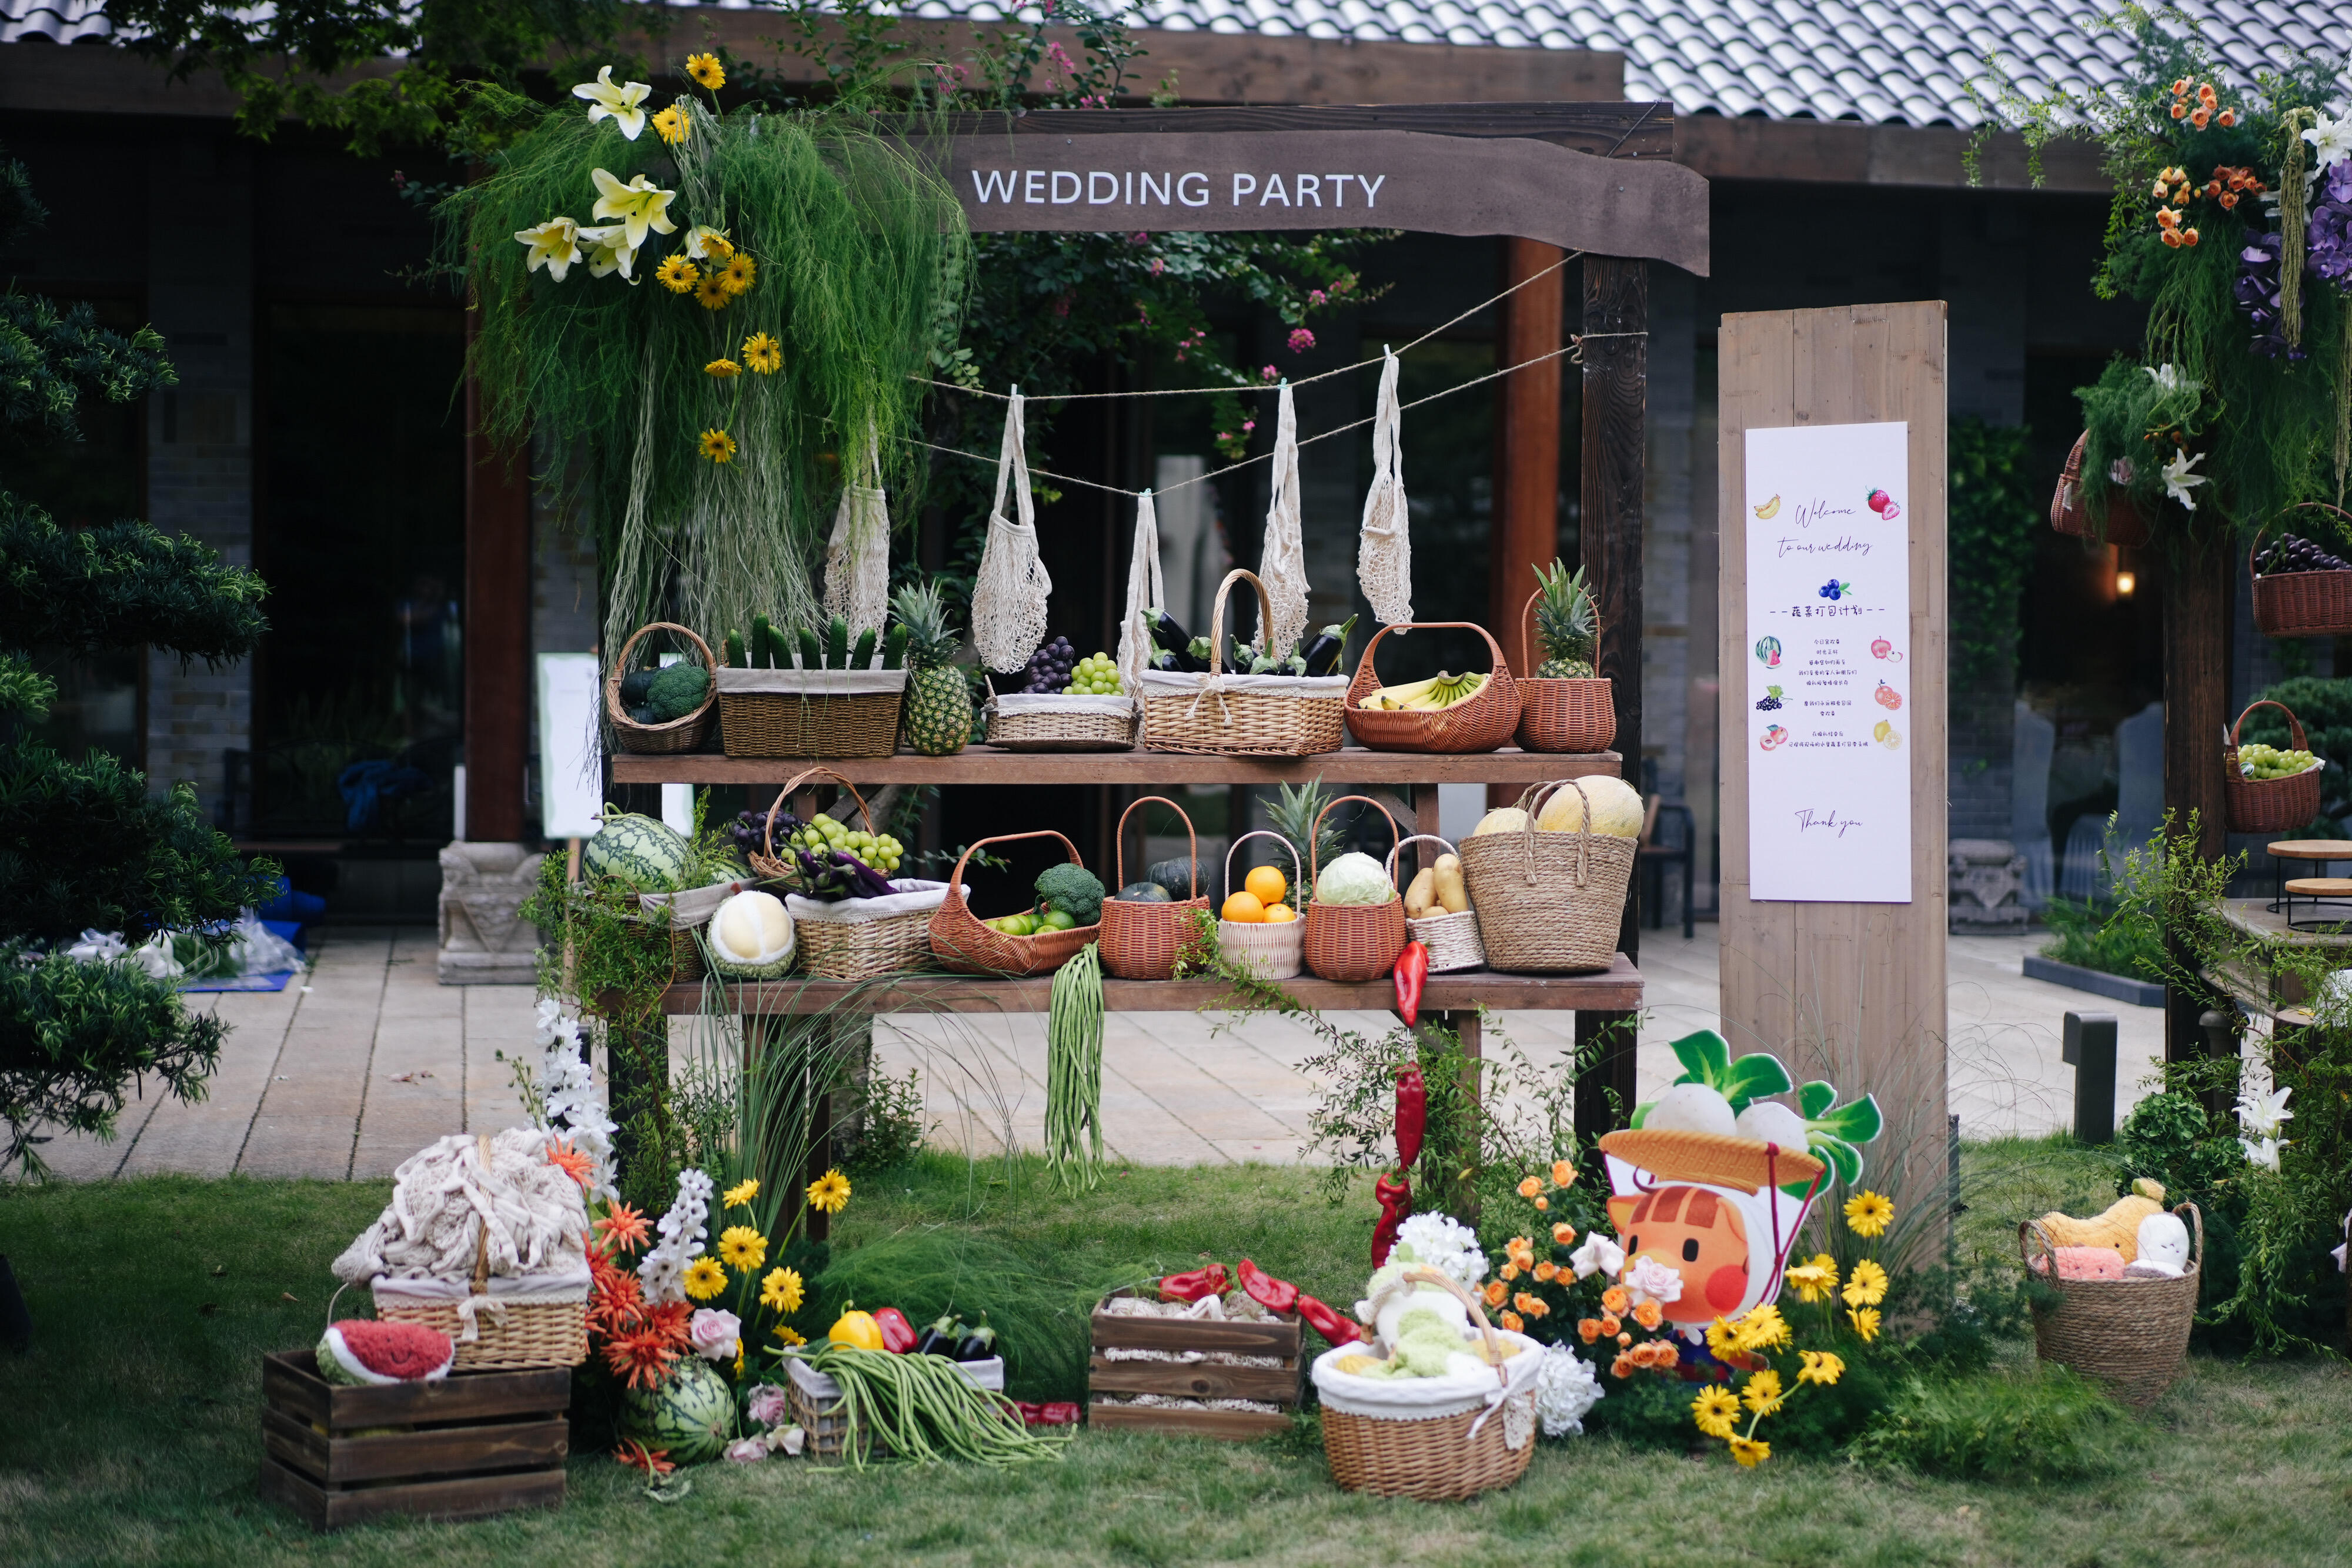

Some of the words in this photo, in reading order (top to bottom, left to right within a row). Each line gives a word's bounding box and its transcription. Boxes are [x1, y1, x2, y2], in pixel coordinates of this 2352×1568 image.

[971, 169, 1210, 207] WEDDING
[1232, 172, 1386, 208] PARTY
[1795, 497, 1856, 529] Welcome
[1777, 536, 1799, 558] to
[1797, 541, 1816, 553] our
[1818, 536, 1873, 556] wedding
[1794, 808, 1838, 833] Thank
[1838, 820, 1863, 838] you
